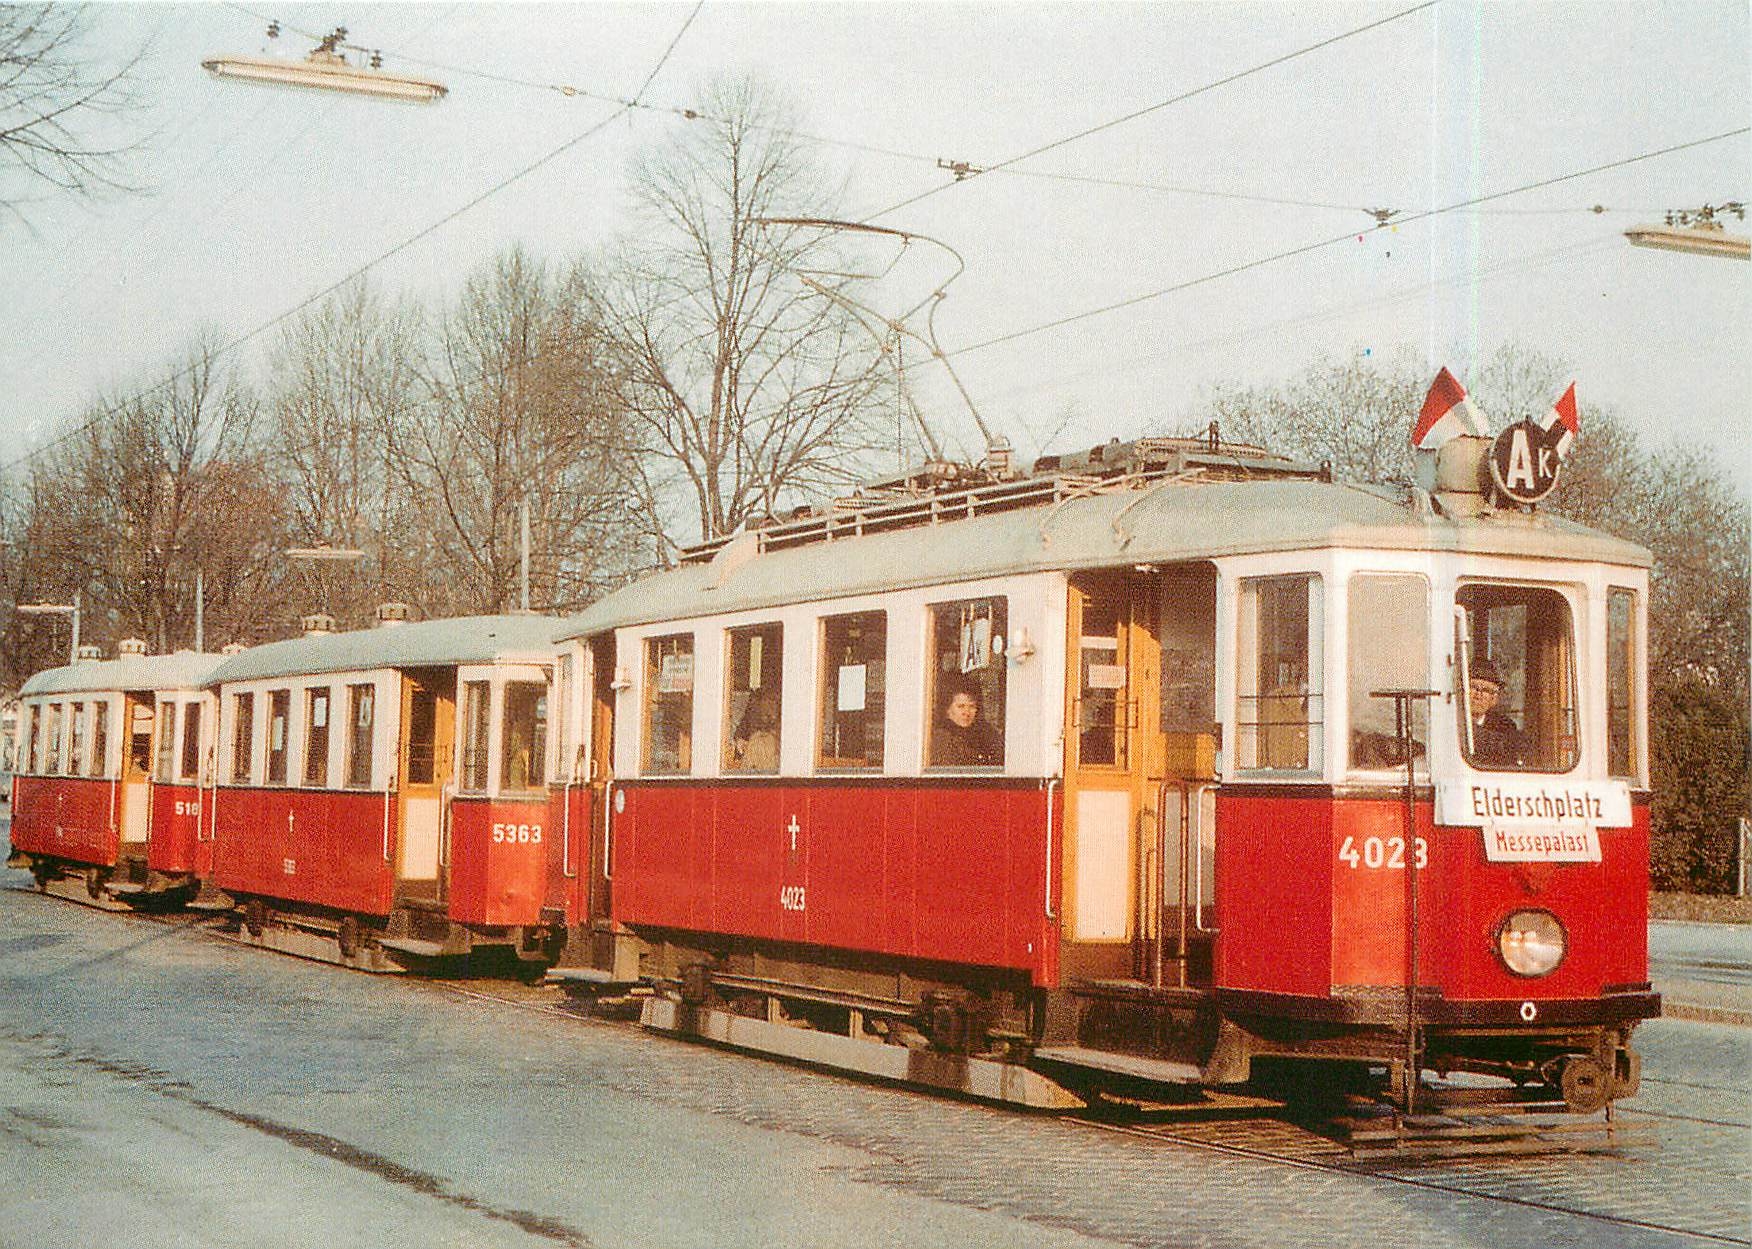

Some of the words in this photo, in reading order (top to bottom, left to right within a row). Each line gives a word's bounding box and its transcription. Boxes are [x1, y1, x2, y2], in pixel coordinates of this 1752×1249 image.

[1472, 786, 1603, 821] Elderschplatz
[492, 823, 542, 844] 5363
[1495, 830, 1589, 855] Messepalast
[1338, 836, 1428, 869] 4023
[780, 885, 805, 911] 4023
